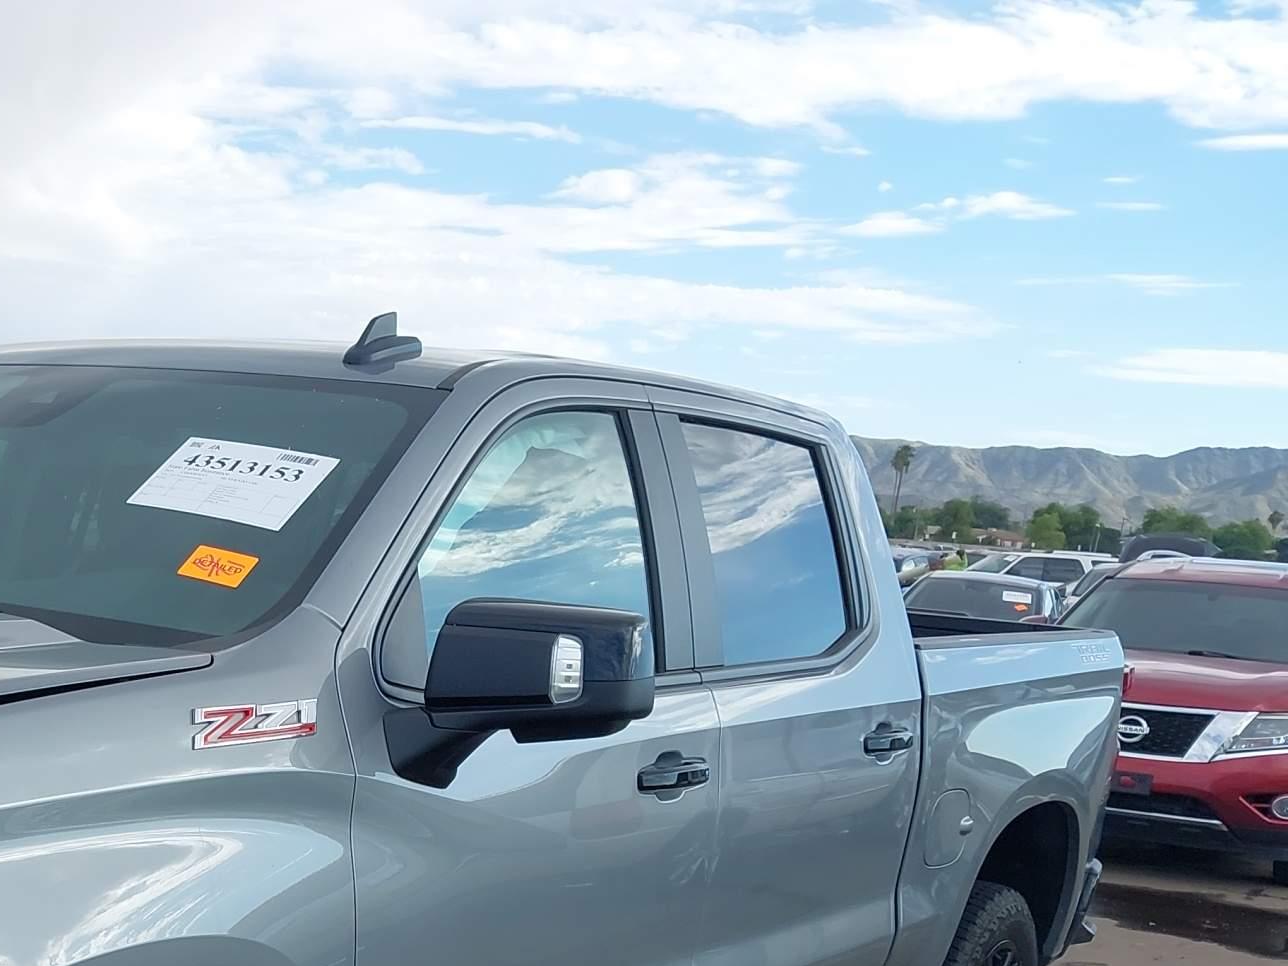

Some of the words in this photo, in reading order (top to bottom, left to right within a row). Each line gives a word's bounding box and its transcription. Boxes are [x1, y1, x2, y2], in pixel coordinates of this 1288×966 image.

[184, 453, 304, 483] 43513153
[1081, 654, 1111, 664] BOSS
[192, 699, 317, 750] Z71
